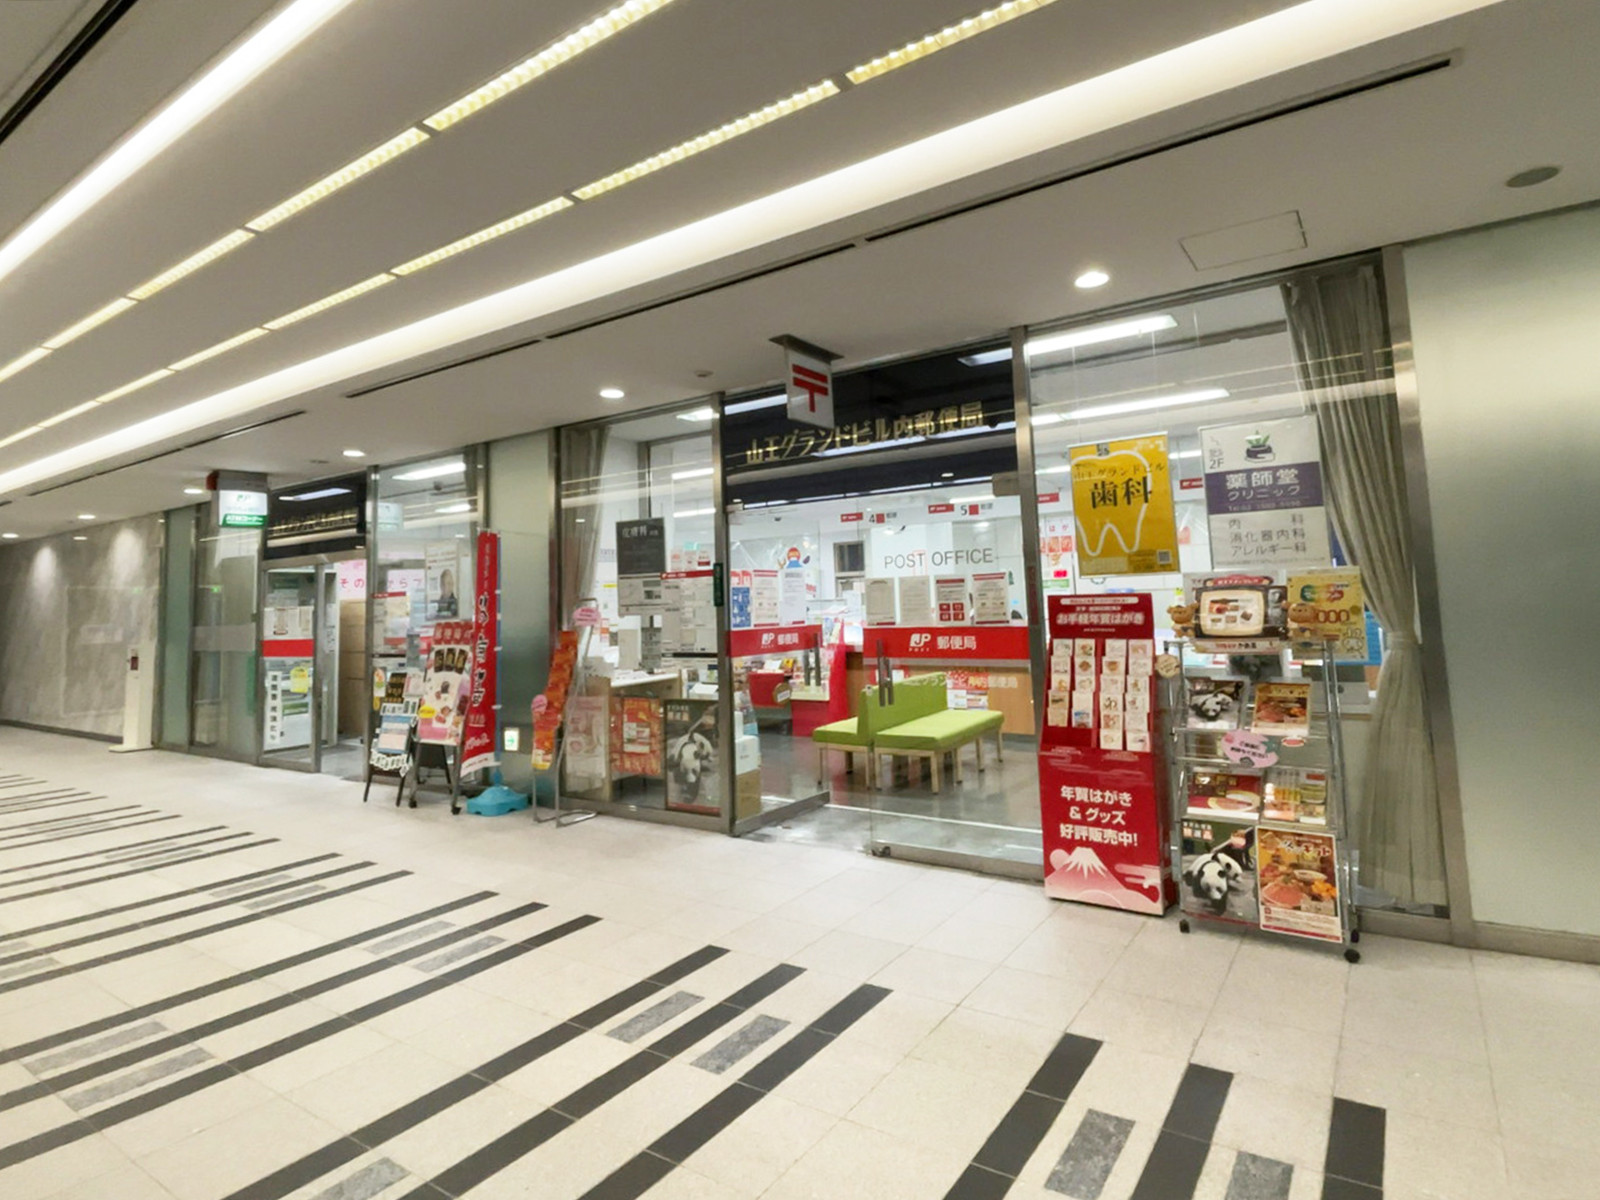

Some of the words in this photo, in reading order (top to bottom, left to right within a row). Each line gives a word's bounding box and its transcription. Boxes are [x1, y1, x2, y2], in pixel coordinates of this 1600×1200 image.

[746, 401, 983, 464] 山王グランドビル内郵便局
[1225, 469, 1299, 490] 薬師堂
[1090, 477, 1152, 509] 歯科
[1228, 485, 1300, 501] クリニック
[884, 553, 927, 569] POST
[931, 548, 993, 567] OFFICE
[1231, 541, 1306, 556] アレルギー科
[1056, 612, 1145, 625] お手軽年賀はがき
[937, 635, 977, 650] 郵便局
[1060, 786, 1132, 807] 年賀はがき
[1069, 806, 1082, 819] &
[1085, 807, 1127, 826] グッズ
[1059, 823, 1138, 846] 好評販売中!
